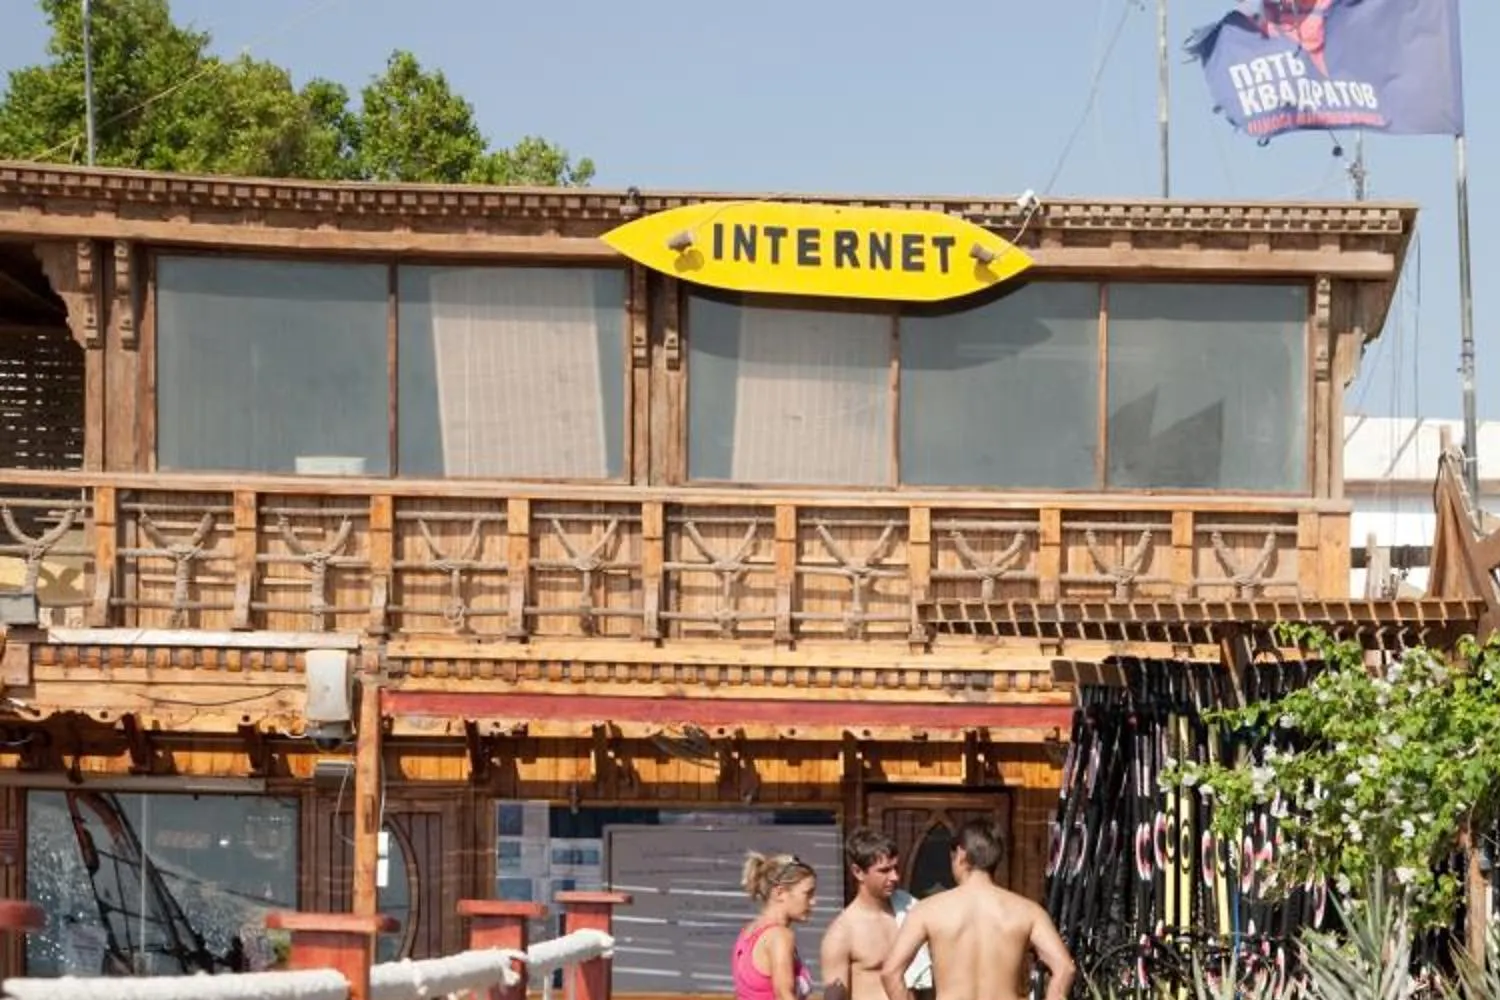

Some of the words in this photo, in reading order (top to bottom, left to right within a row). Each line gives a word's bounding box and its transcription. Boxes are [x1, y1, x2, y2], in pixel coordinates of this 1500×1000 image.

[1229, 51, 1307, 89] ПЯТЬ
[1238, 78, 1379, 117] КВАДРАТОВ
[712, 222, 957, 274] INTERNET
